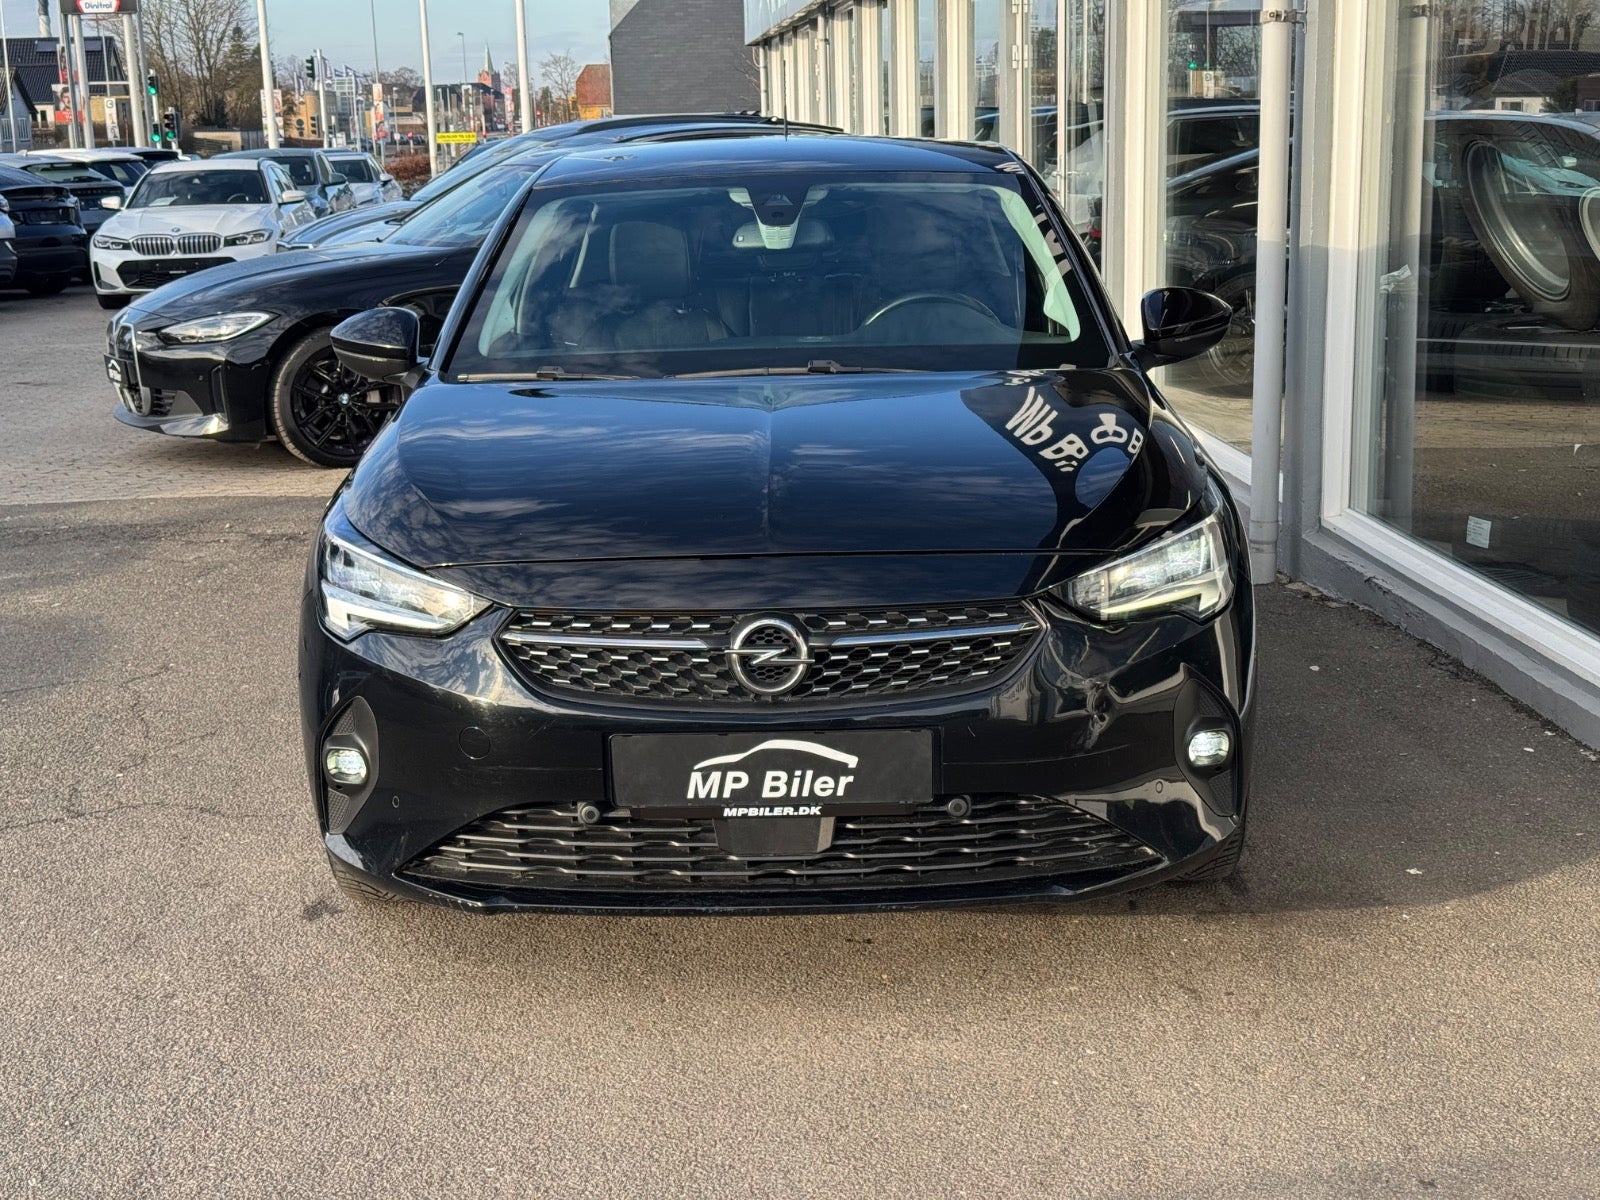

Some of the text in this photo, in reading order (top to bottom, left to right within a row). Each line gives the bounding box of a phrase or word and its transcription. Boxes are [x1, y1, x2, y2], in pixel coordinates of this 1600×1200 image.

[686, 769, 855, 799] MP Biler
[723, 806, 822, 817] MPBILER.DK
